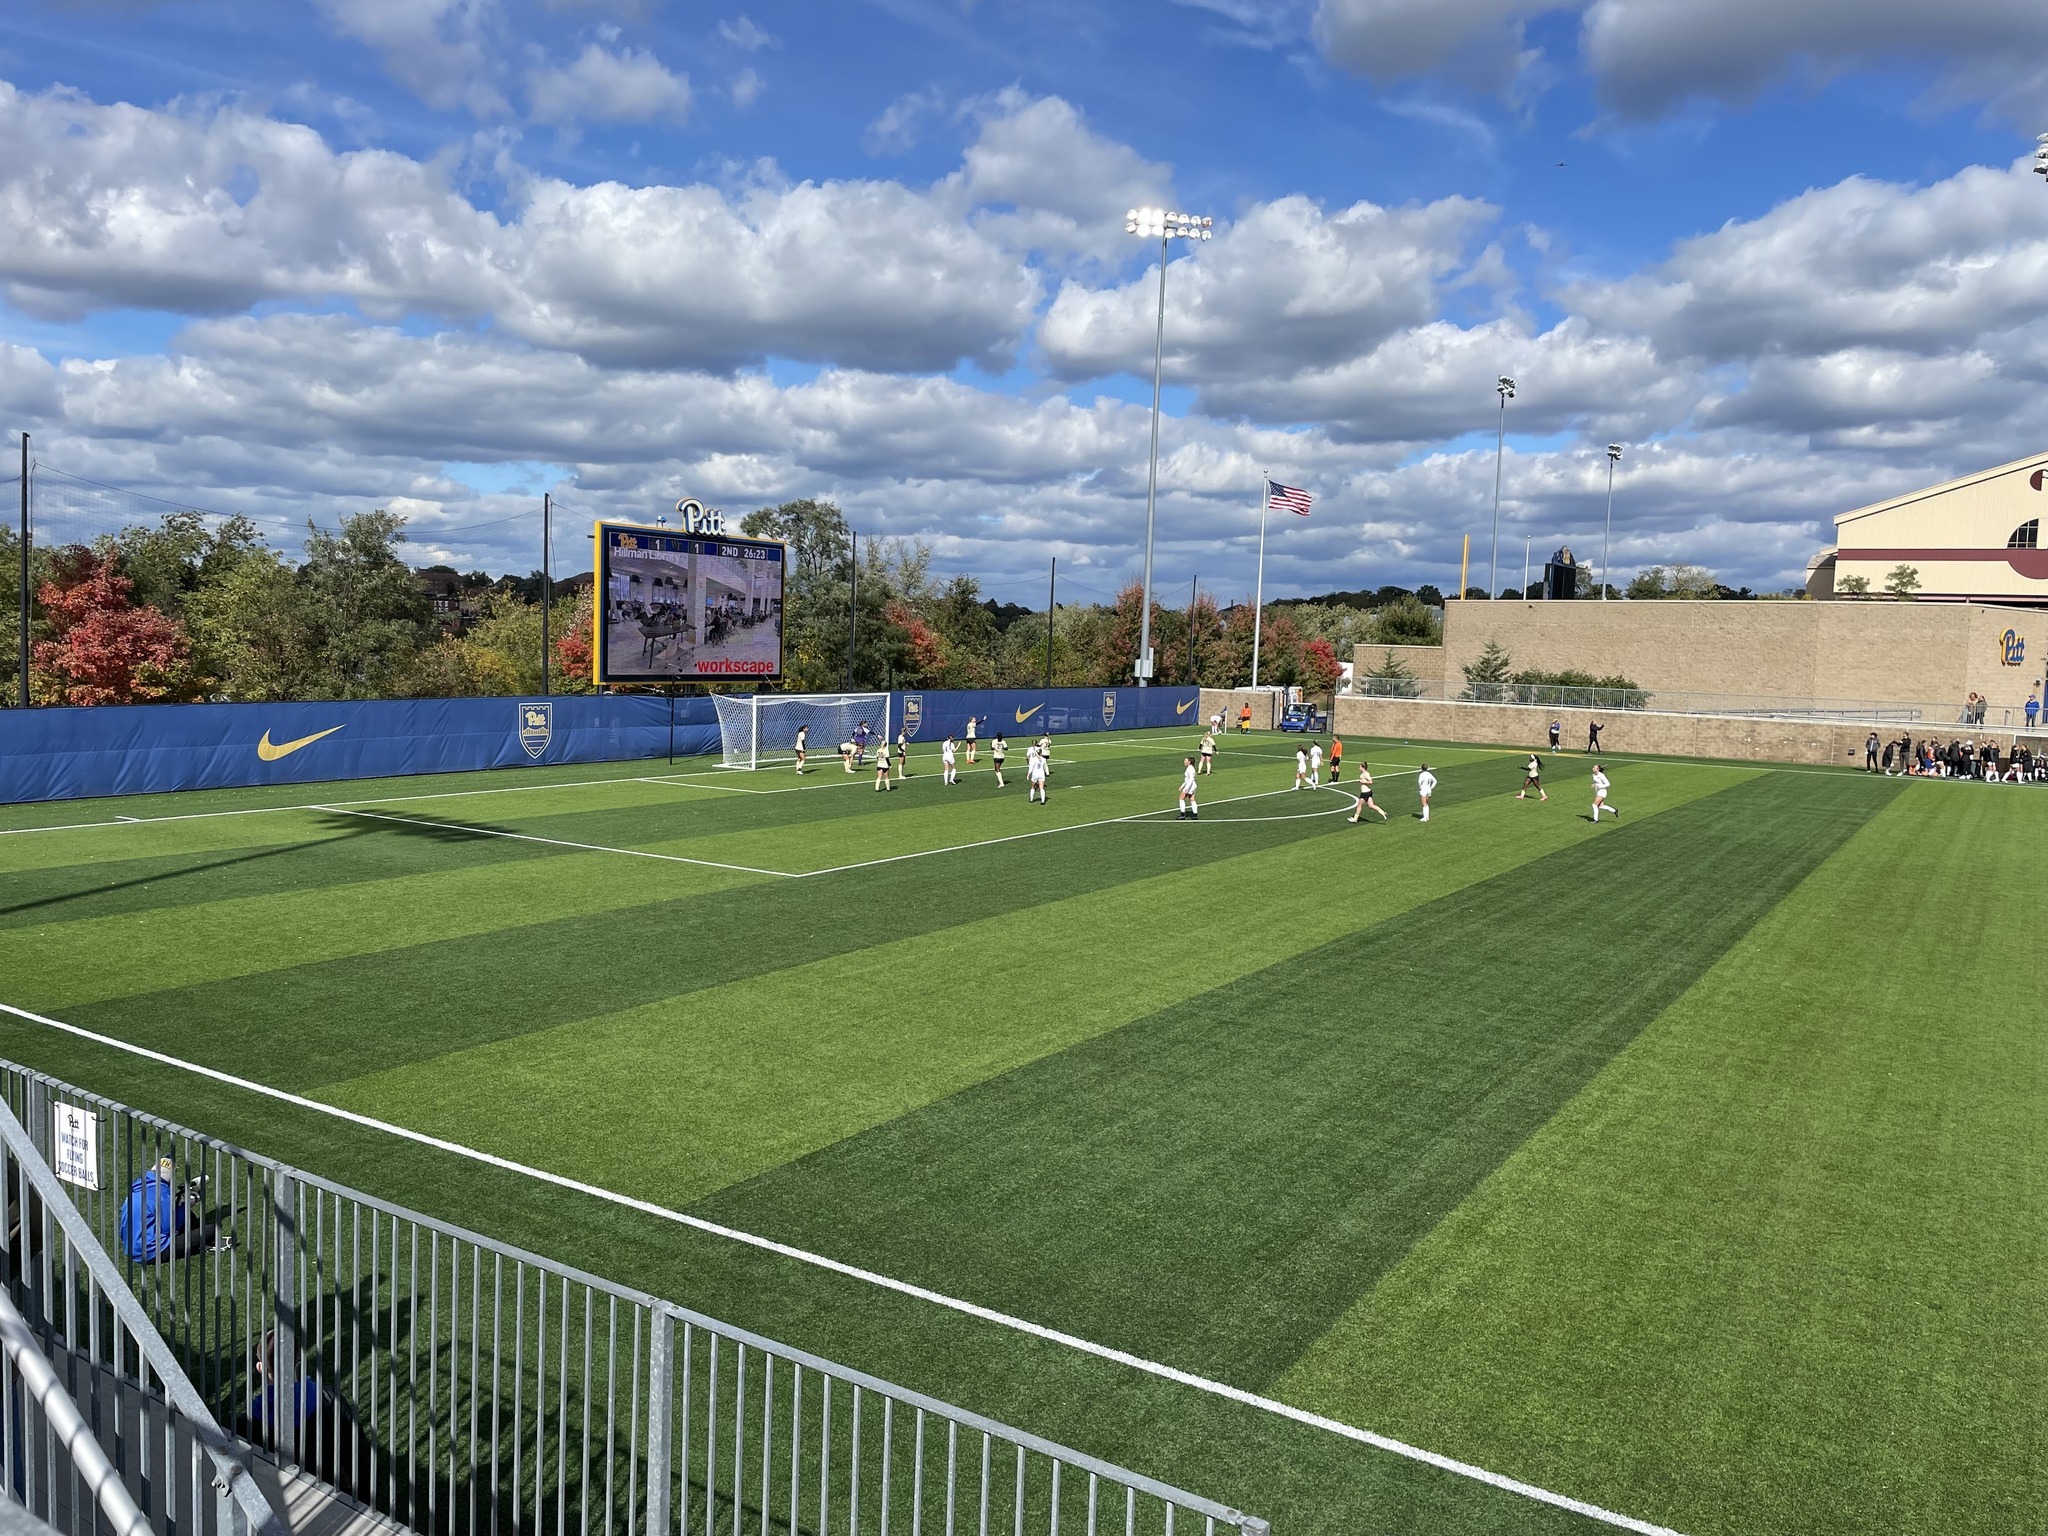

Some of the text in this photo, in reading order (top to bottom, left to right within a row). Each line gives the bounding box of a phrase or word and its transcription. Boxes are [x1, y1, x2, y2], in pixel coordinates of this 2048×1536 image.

[676, 498, 727, 536] Pitt
[614, 546, 648, 559] Hillman
[618, 533, 638, 549] Pitt
[655, 539, 660, 550] 1
[694, 543, 700, 554] 1
[721, 546, 739, 557] 2ND
[744, 549, 766, 560] 26:23
[2000, 628, 2025, 665] Pitt
[697, 657, 774, 675] workscape
[525, 711, 546, 726] Pitt
[67, 1114, 79, 1129] Pitt
[61, 1132, 89, 1151] WATCH FOR
[66, 1149, 84, 1164] FLYING
[59, 1161, 94, 1183] SOCCER BALLS
